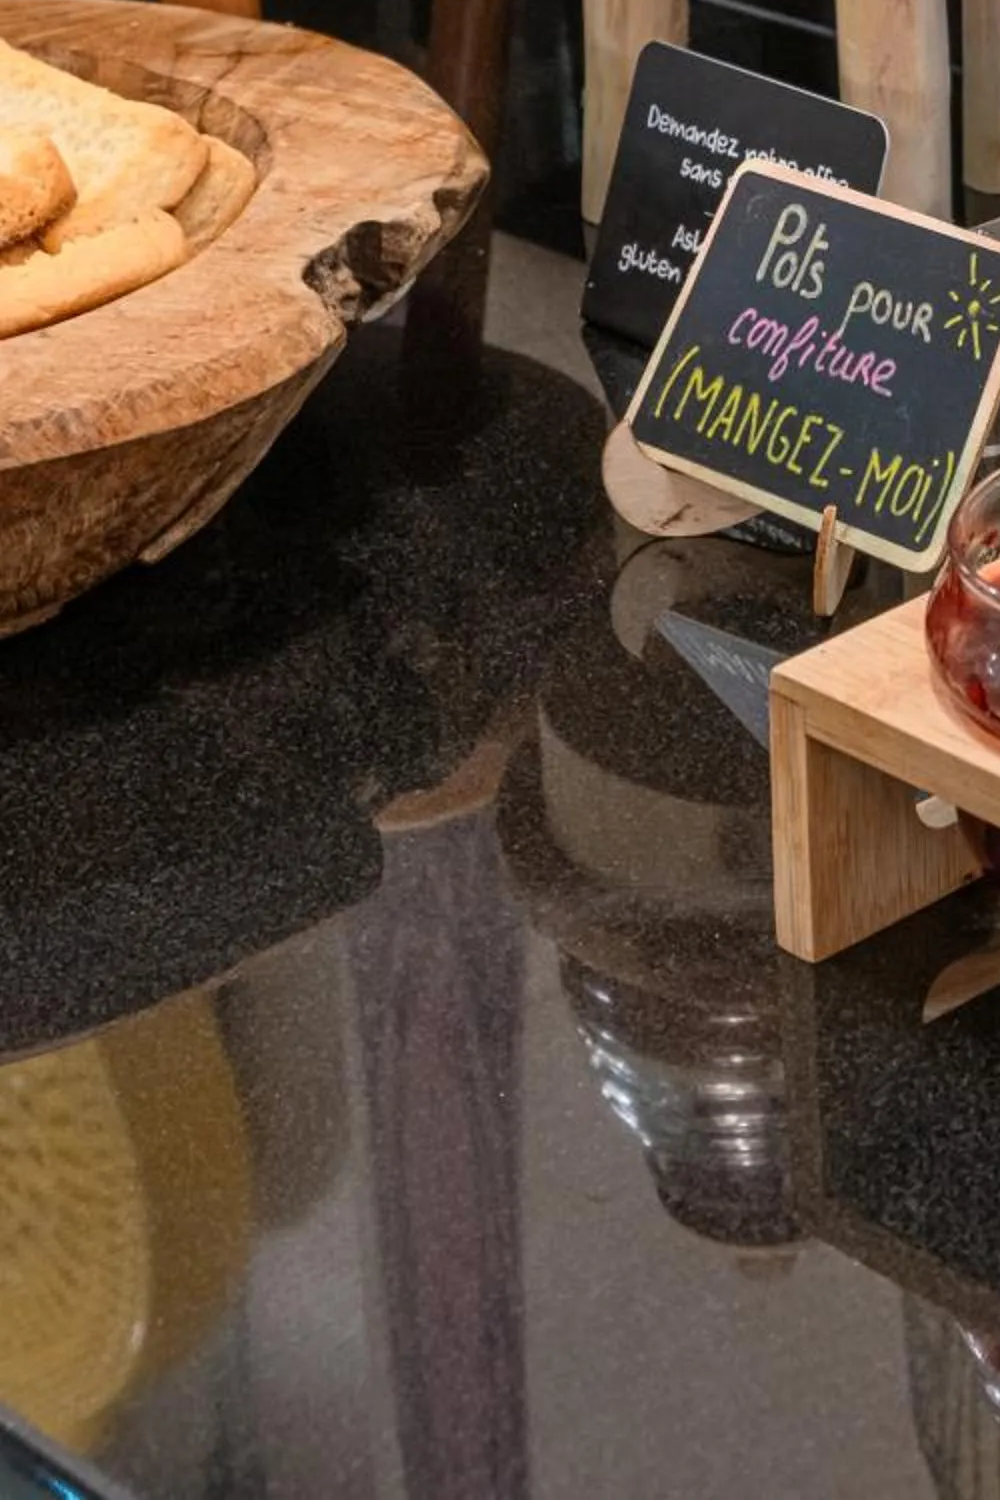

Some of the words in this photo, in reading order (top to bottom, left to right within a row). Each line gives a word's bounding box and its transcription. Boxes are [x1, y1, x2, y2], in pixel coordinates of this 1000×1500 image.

[647, 104, 739, 158] Demandez
[680, 157, 722, 188] sans
[618, 244, 681, 284] gluten
[727, 306, 898, 398] confiture
